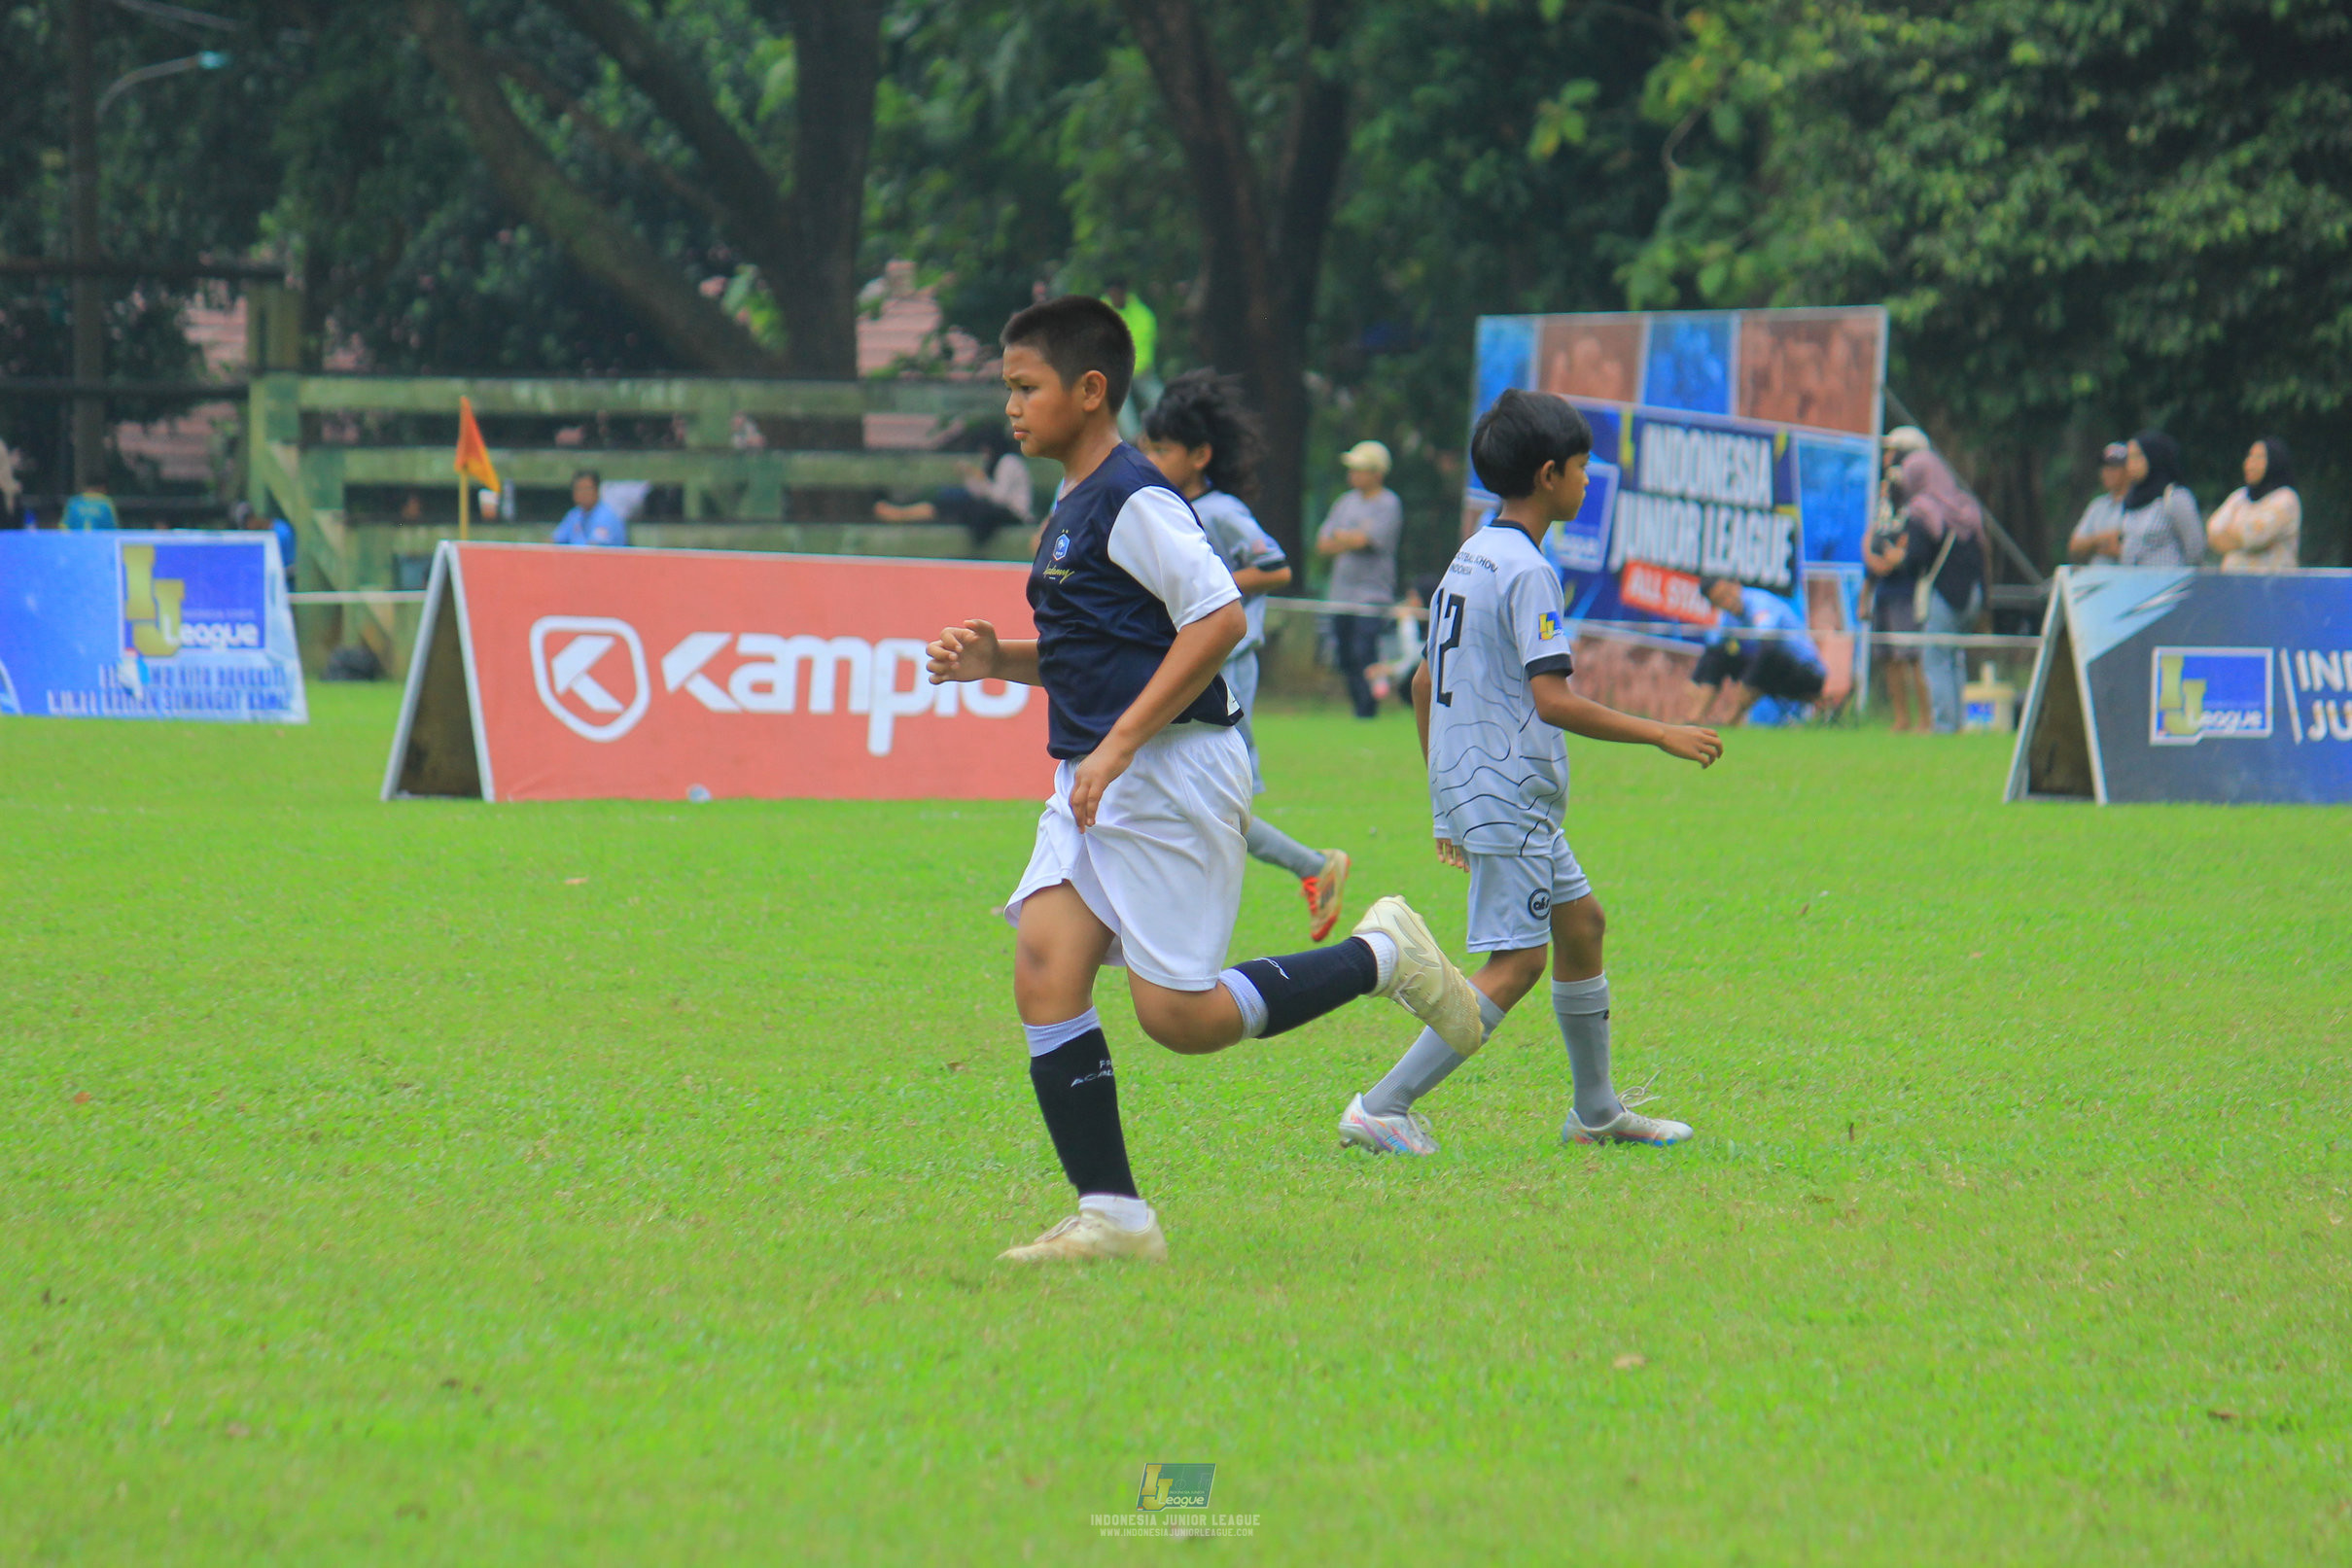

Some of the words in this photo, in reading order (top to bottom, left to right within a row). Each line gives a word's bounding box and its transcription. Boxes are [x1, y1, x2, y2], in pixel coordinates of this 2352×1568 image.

[1639, 421, 1773, 509] INDONESIA
[1607, 489, 1701, 575] JUNIOR
[1702, 502, 1795, 587] LEAGUE
[1629, 570, 1662, 606] ALL
[162, 613, 259, 651] League
[2188, 706, 2263, 734] League
